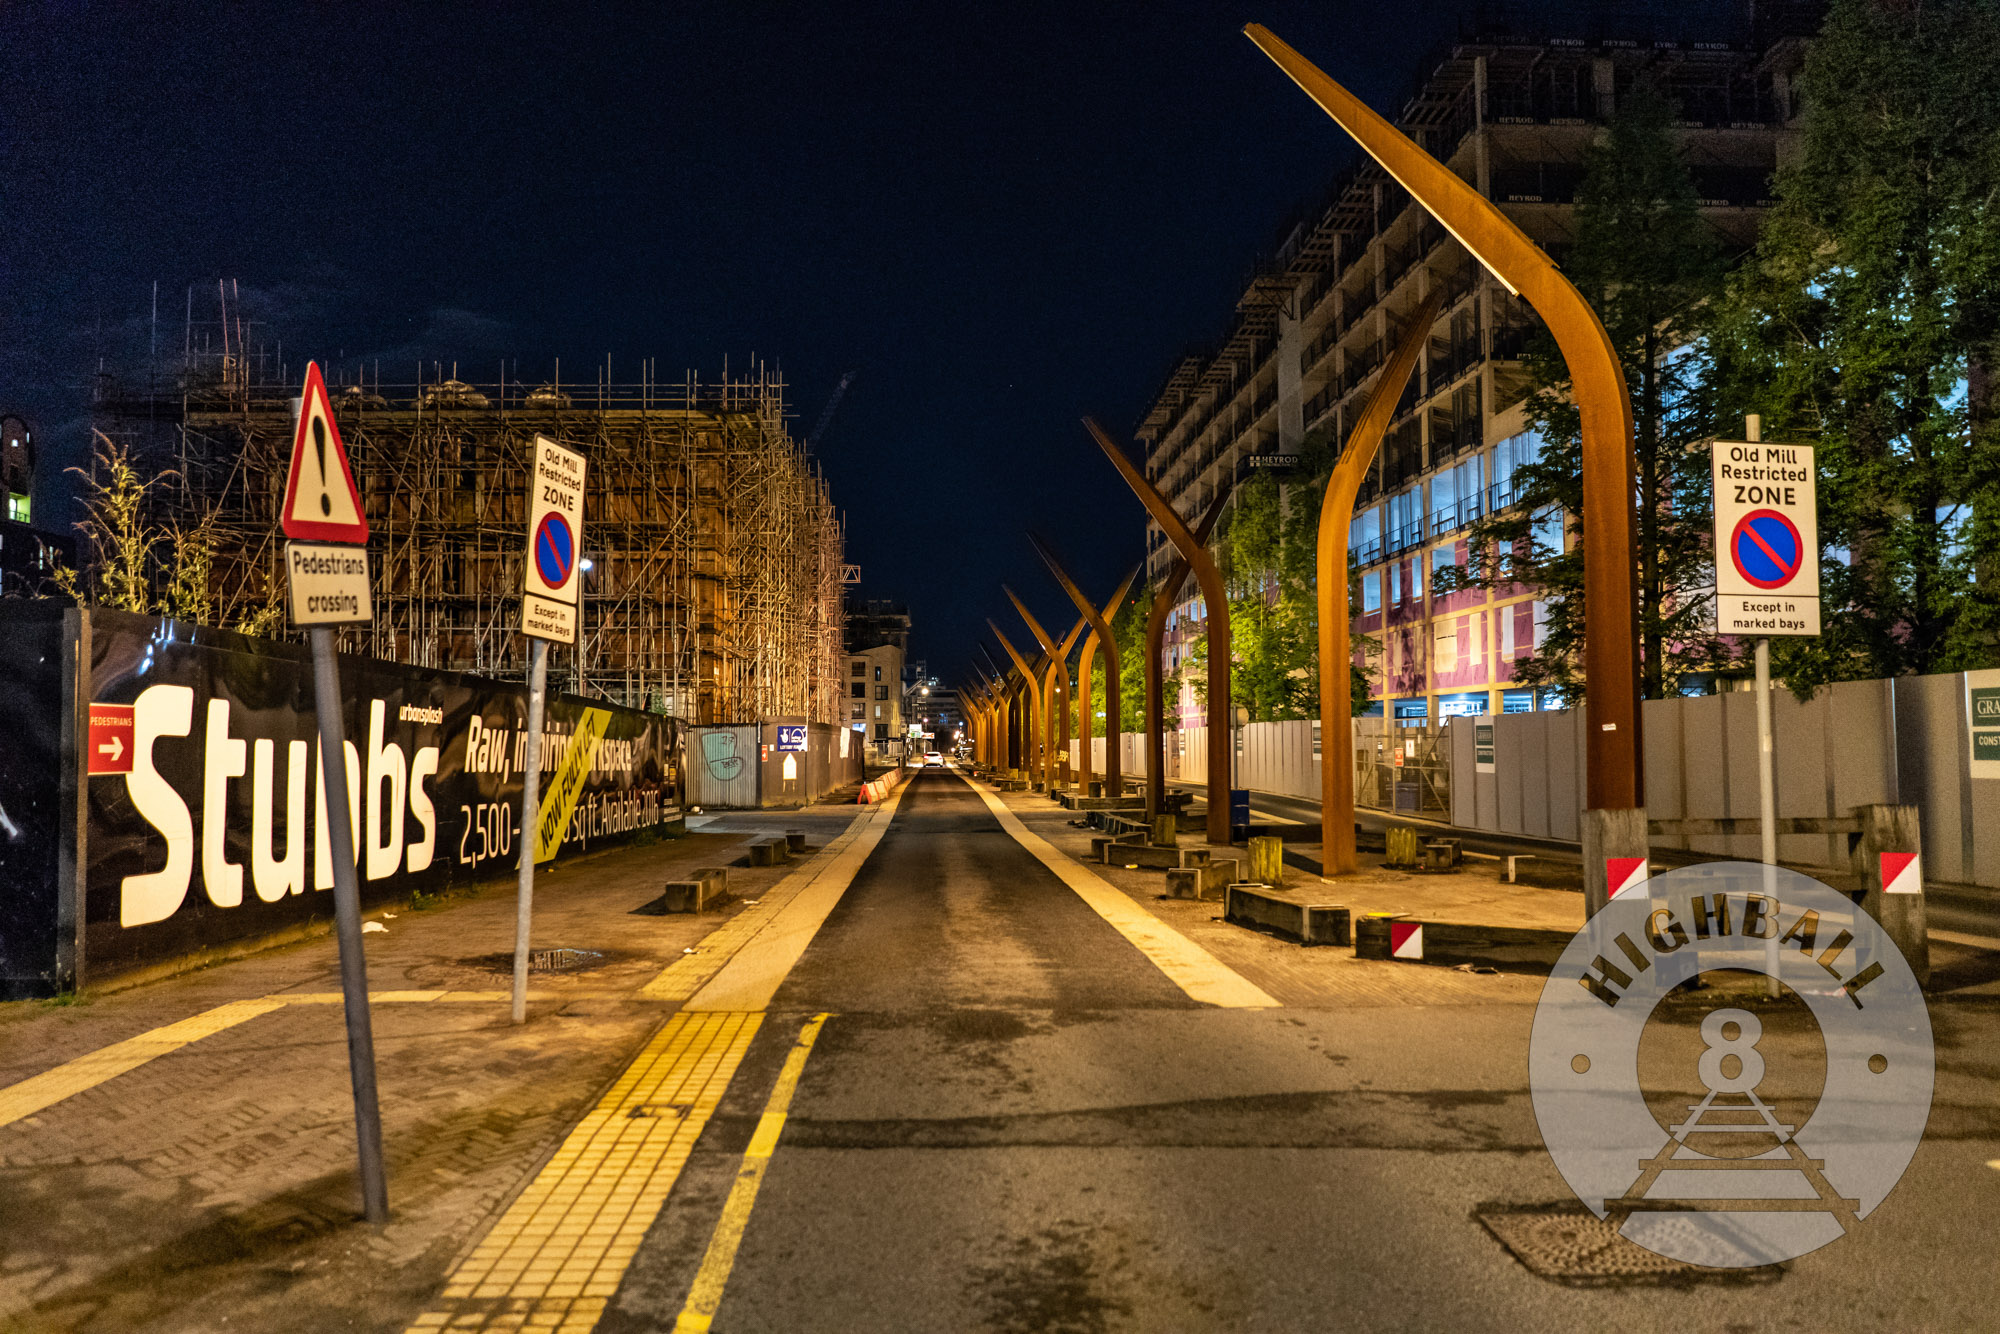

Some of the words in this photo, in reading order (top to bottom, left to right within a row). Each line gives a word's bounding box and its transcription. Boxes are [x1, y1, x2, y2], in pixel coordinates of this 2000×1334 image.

[1550, 38, 1585, 46] HEYROD
[1499, 116, 1534, 124] HEYROD
[1508, 194, 1542, 202] HEYROD
[545, 448, 560, 466] Old
[562, 455, 577, 474] Mill
[1262, 456, 1298, 464] HEYROD
[1730, 447, 1759, 462] Old
[1766, 448, 1797, 464] Mill
[539, 462, 581, 491] Restricted
[1721, 464, 1807, 482] Restricted
[543, 485, 574, 512] ZONE
[1734, 485, 1796, 506] ZONE
[293, 551, 364, 575] Pedestrians
[307, 590, 358, 616] crossing
[534, 604, 558, 620] Except
[559, 610, 566, 621] in
[1742, 601, 1781, 613] Except
[1785, 602, 1795, 612] in
[528, 619, 553, 632] marked
[554, 623, 570, 637] bays
[1733, 618, 1775, 629] marked
[1779, 618, 1805, 630] bays
[90, 716, 133, 727] PEDESTRIANS
[399, 702, 443, 726] urbansplash
[464, 715, 510, 785] Raw,
[513, 717, 573, 773] inirin
[541, 789, 562, 856] NOW
[562, 739, 583, 808] FULLY
[583, 711, 596, 756] LET
[572, 804, 585, 851] sq
[587, 791, 599, 838] ft.
[601, 789, 641, 836] Available
[641, 788, 659, 828] 2016
[459, 801, 511, 870] 2,500
